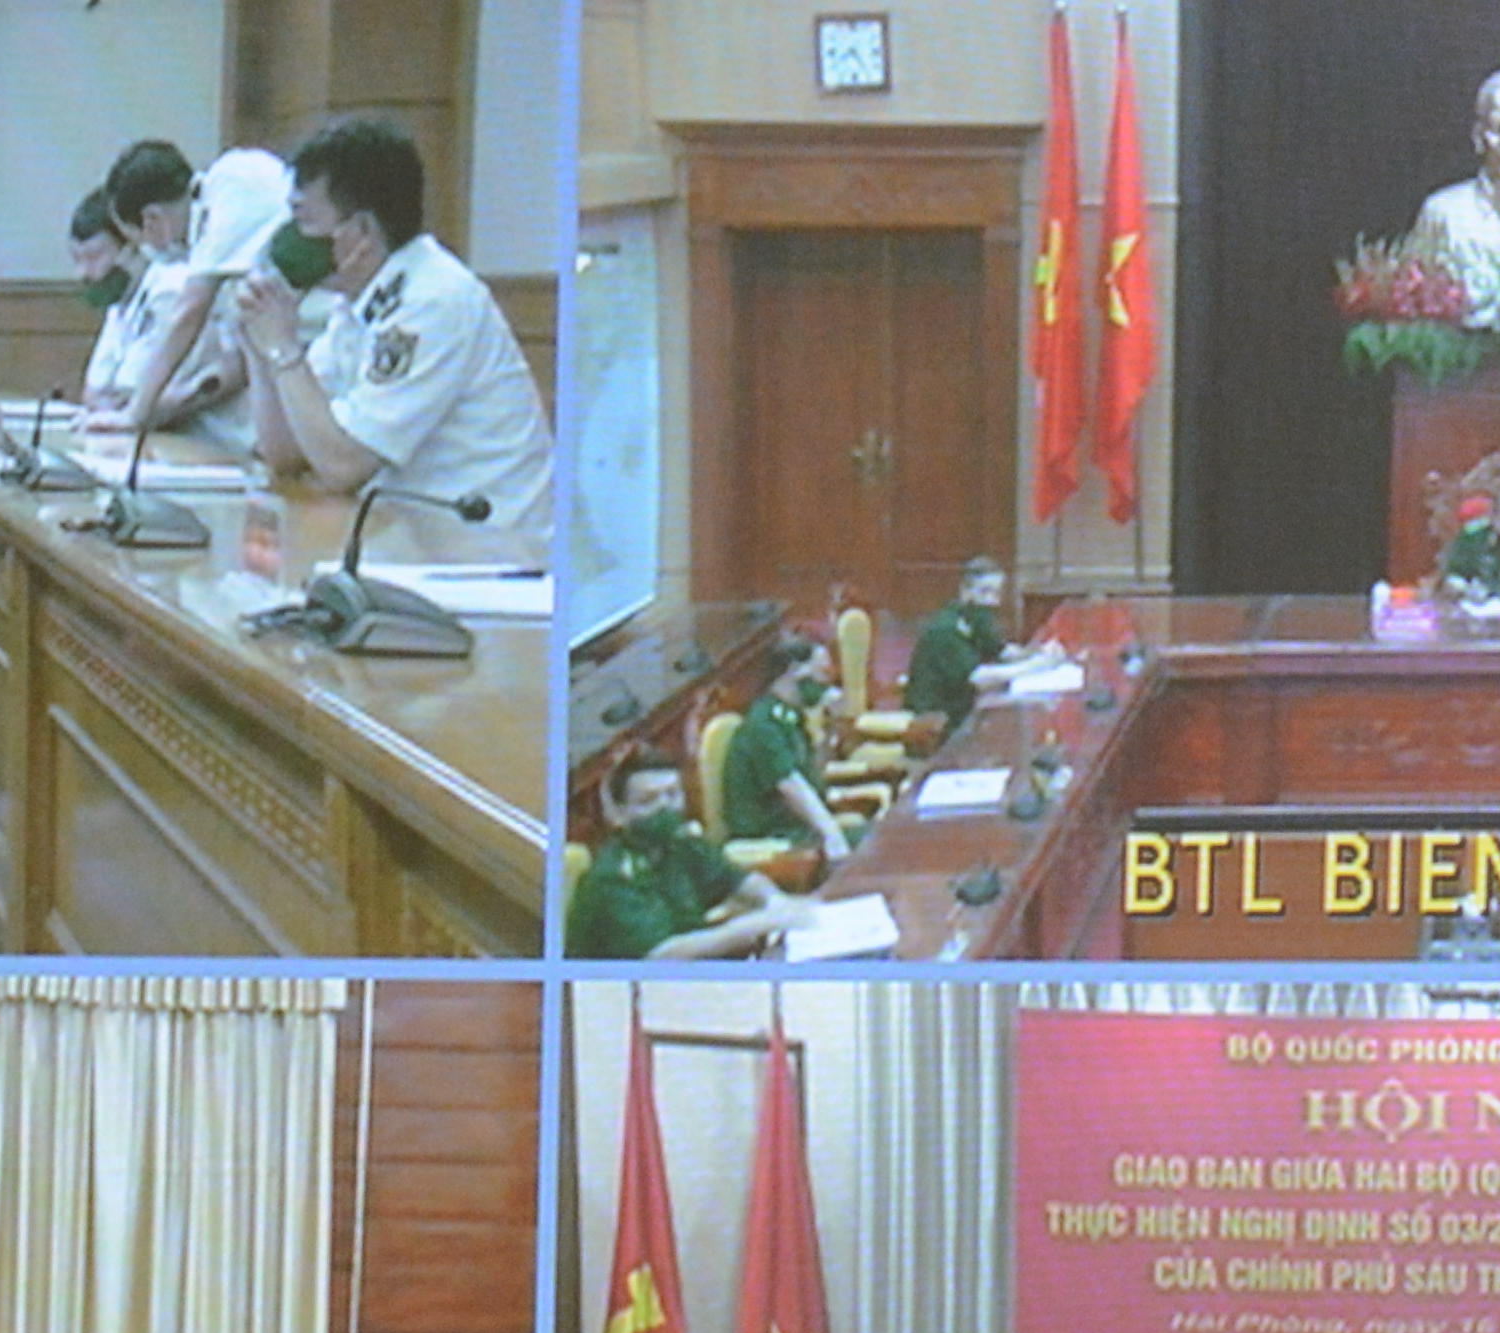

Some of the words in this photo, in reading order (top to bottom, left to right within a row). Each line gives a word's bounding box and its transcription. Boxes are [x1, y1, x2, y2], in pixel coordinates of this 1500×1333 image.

[1123, 831, 1283, 914] BTL
[1226, 1032, 1273, 1066] BỘ
[1305, 1078, 1450, 1143] HỘI
[1114, 1154, 1189, 1188] GIAO
[1197, 1156, 1263, 1189] BAN
[1355, 1159, 1408, 1190] HAI
[1416, 1157, 1459, 1197] BỘ
